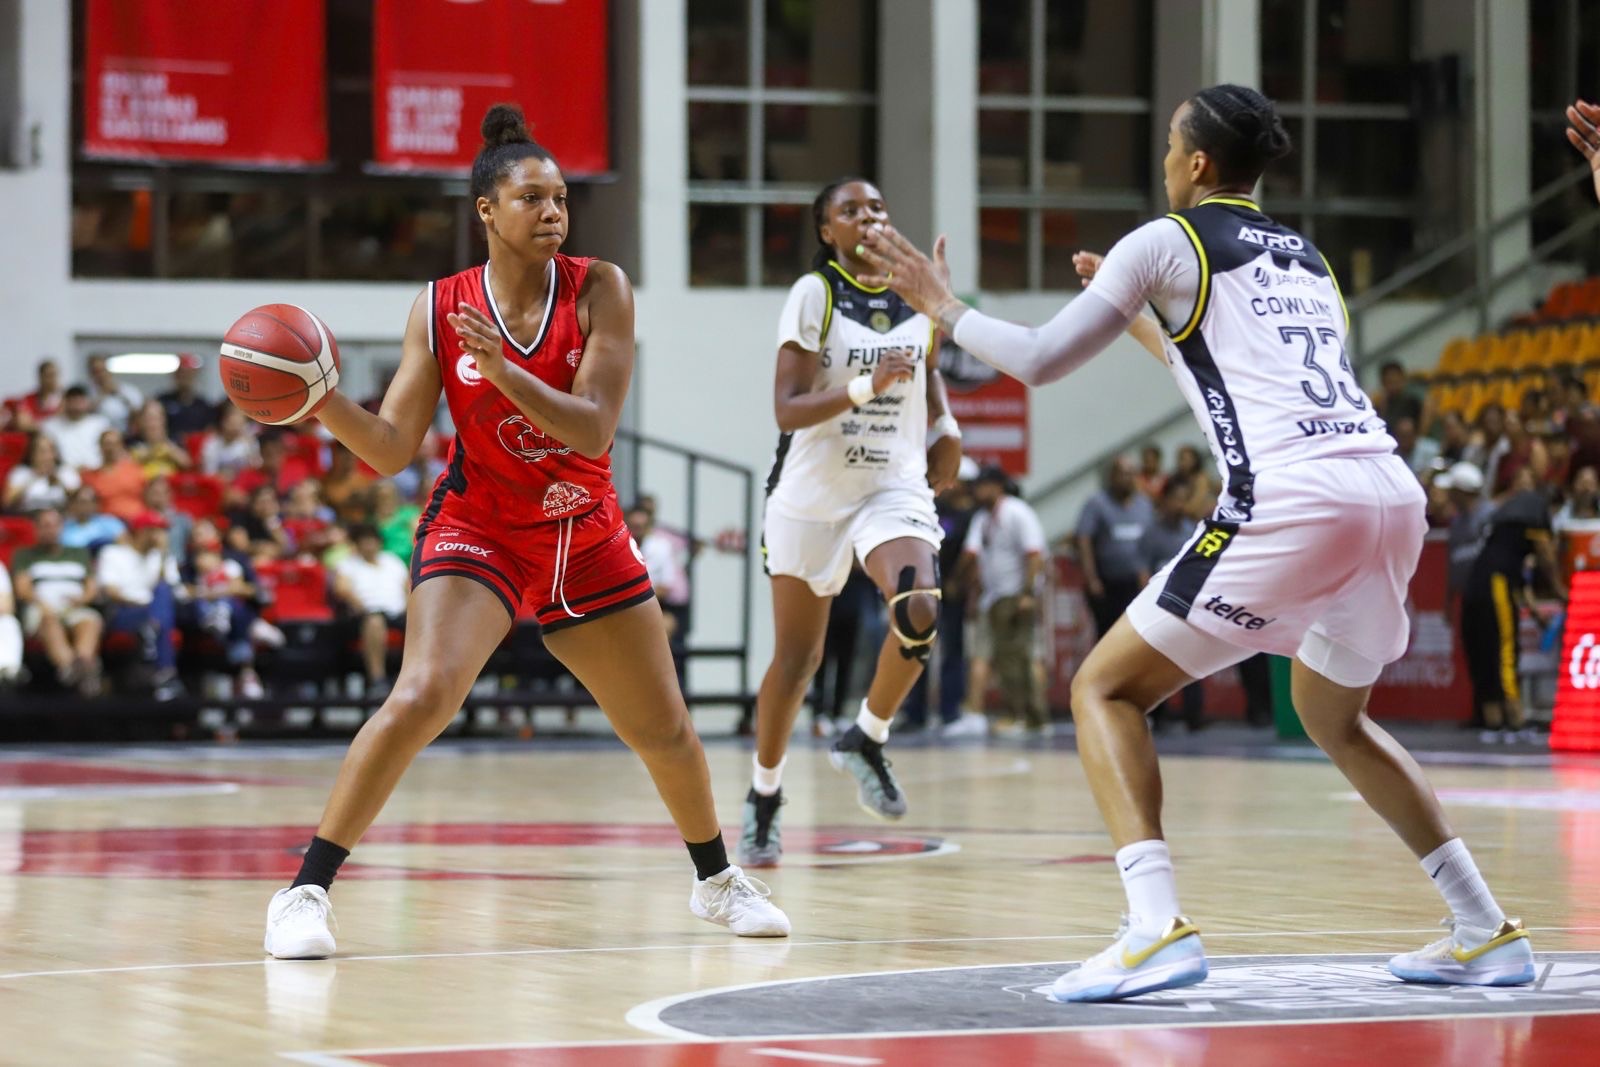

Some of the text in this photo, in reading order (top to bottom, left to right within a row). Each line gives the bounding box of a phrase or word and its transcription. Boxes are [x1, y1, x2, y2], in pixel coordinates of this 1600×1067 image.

[1237, 226, 1304, 252] ATRO
[1278, 326, 1366, 411] 33
[434, 541, 495, 558] Comex
